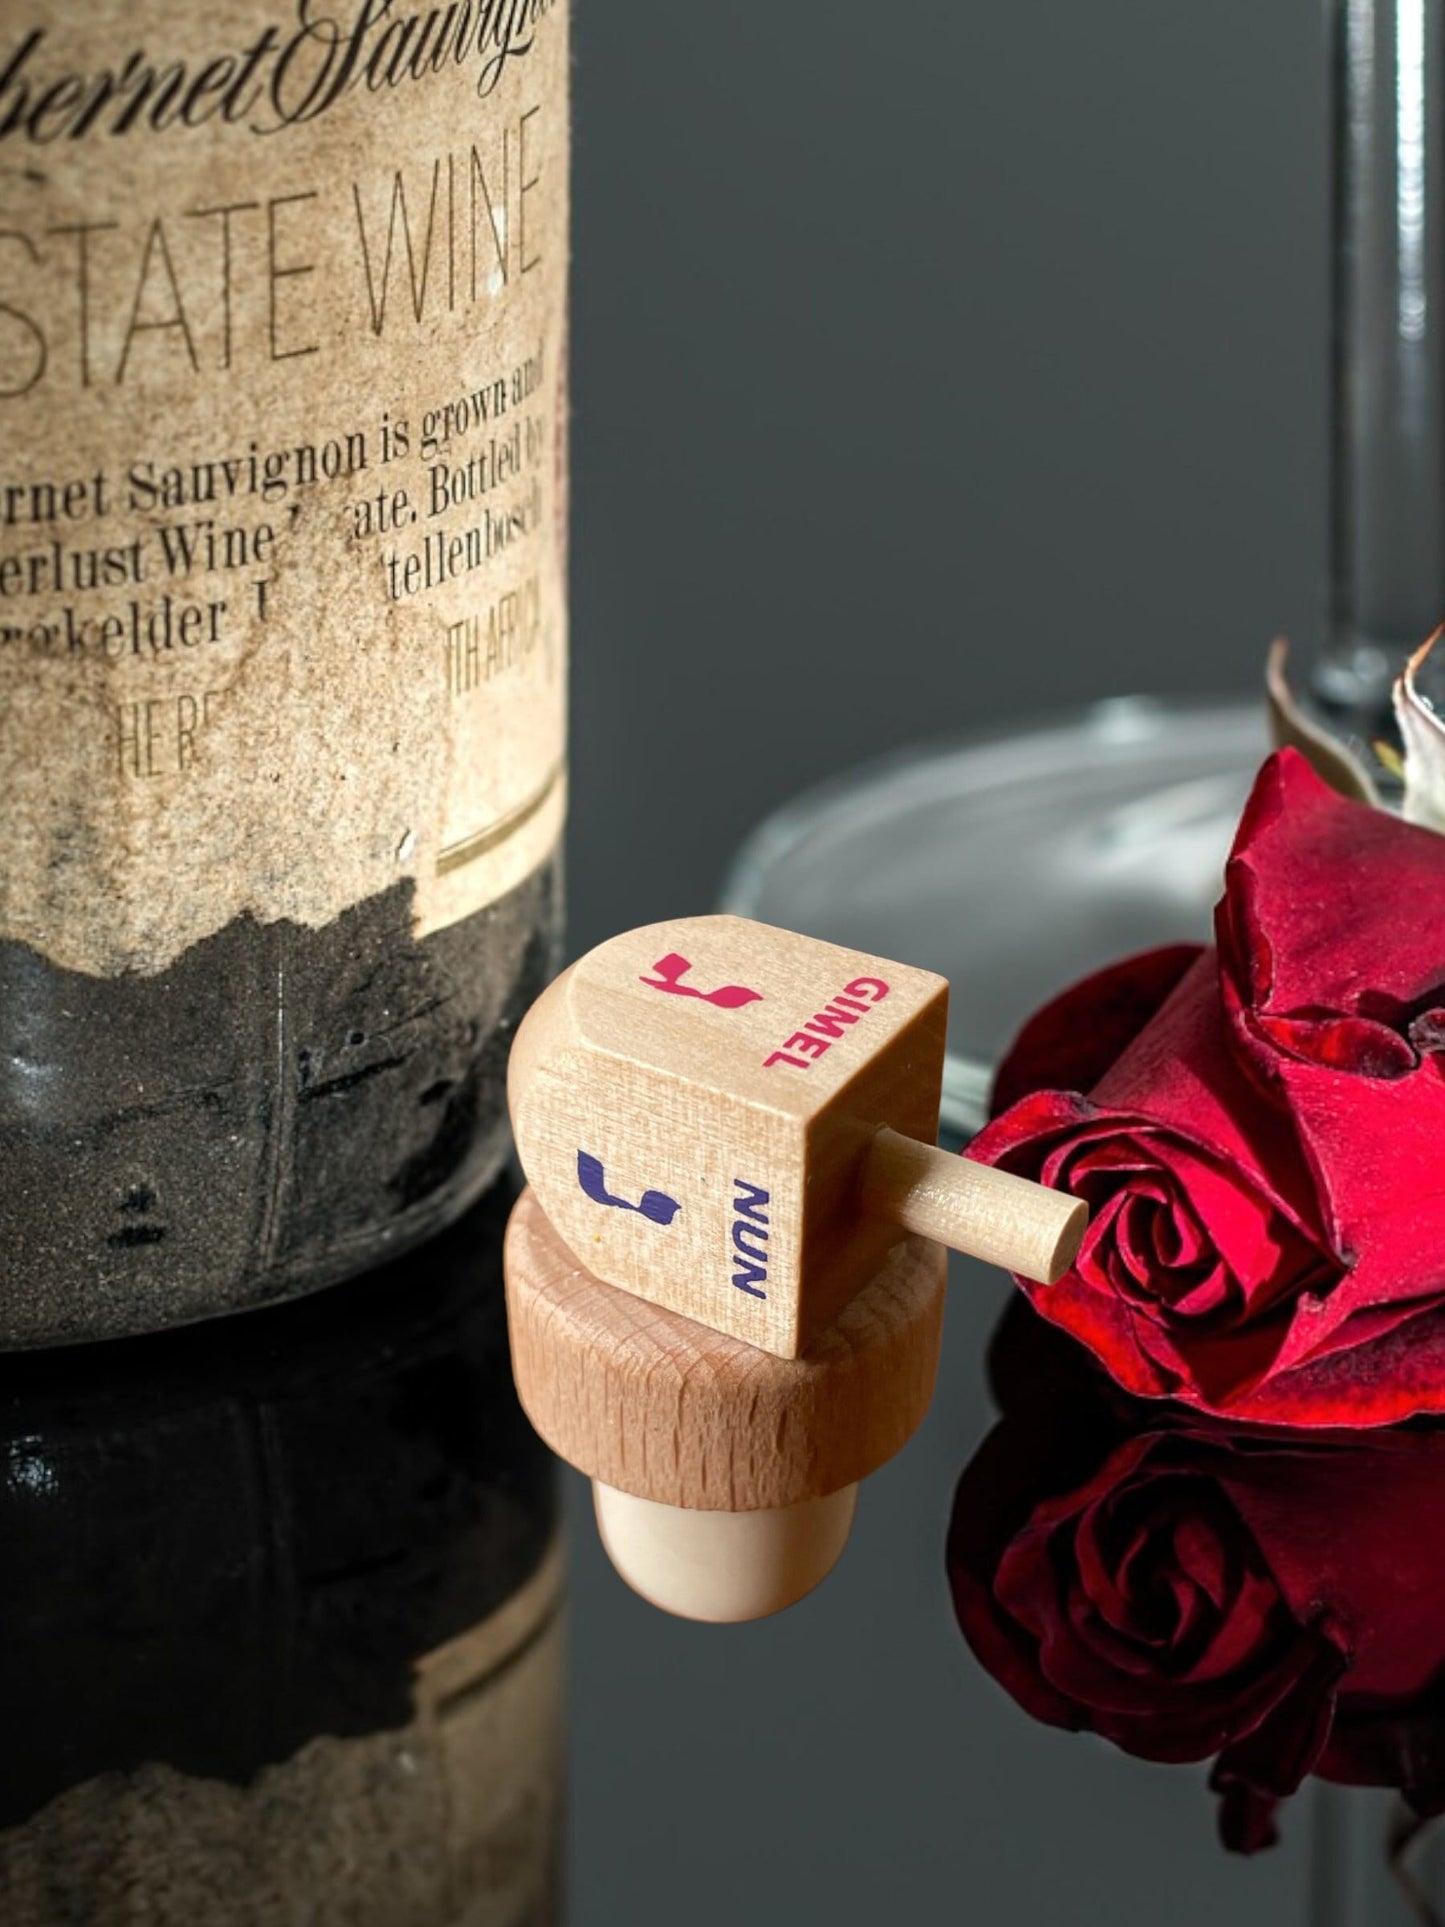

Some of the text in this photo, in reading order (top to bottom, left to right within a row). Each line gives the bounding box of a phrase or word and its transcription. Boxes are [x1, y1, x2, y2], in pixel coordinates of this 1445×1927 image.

[352, 105, 542, 337] WINE
[126, 426, 369, 513] Sauvignon
[380, 412, 410, 464] is
[420, 378, 507, 461] grown
[156, 520, 274, 576] Wine
[428, 422, 520, 519] Bottled
[762, 977, 890, 1070] GIMEL
[732, 1178, 770, 1300] NUN
